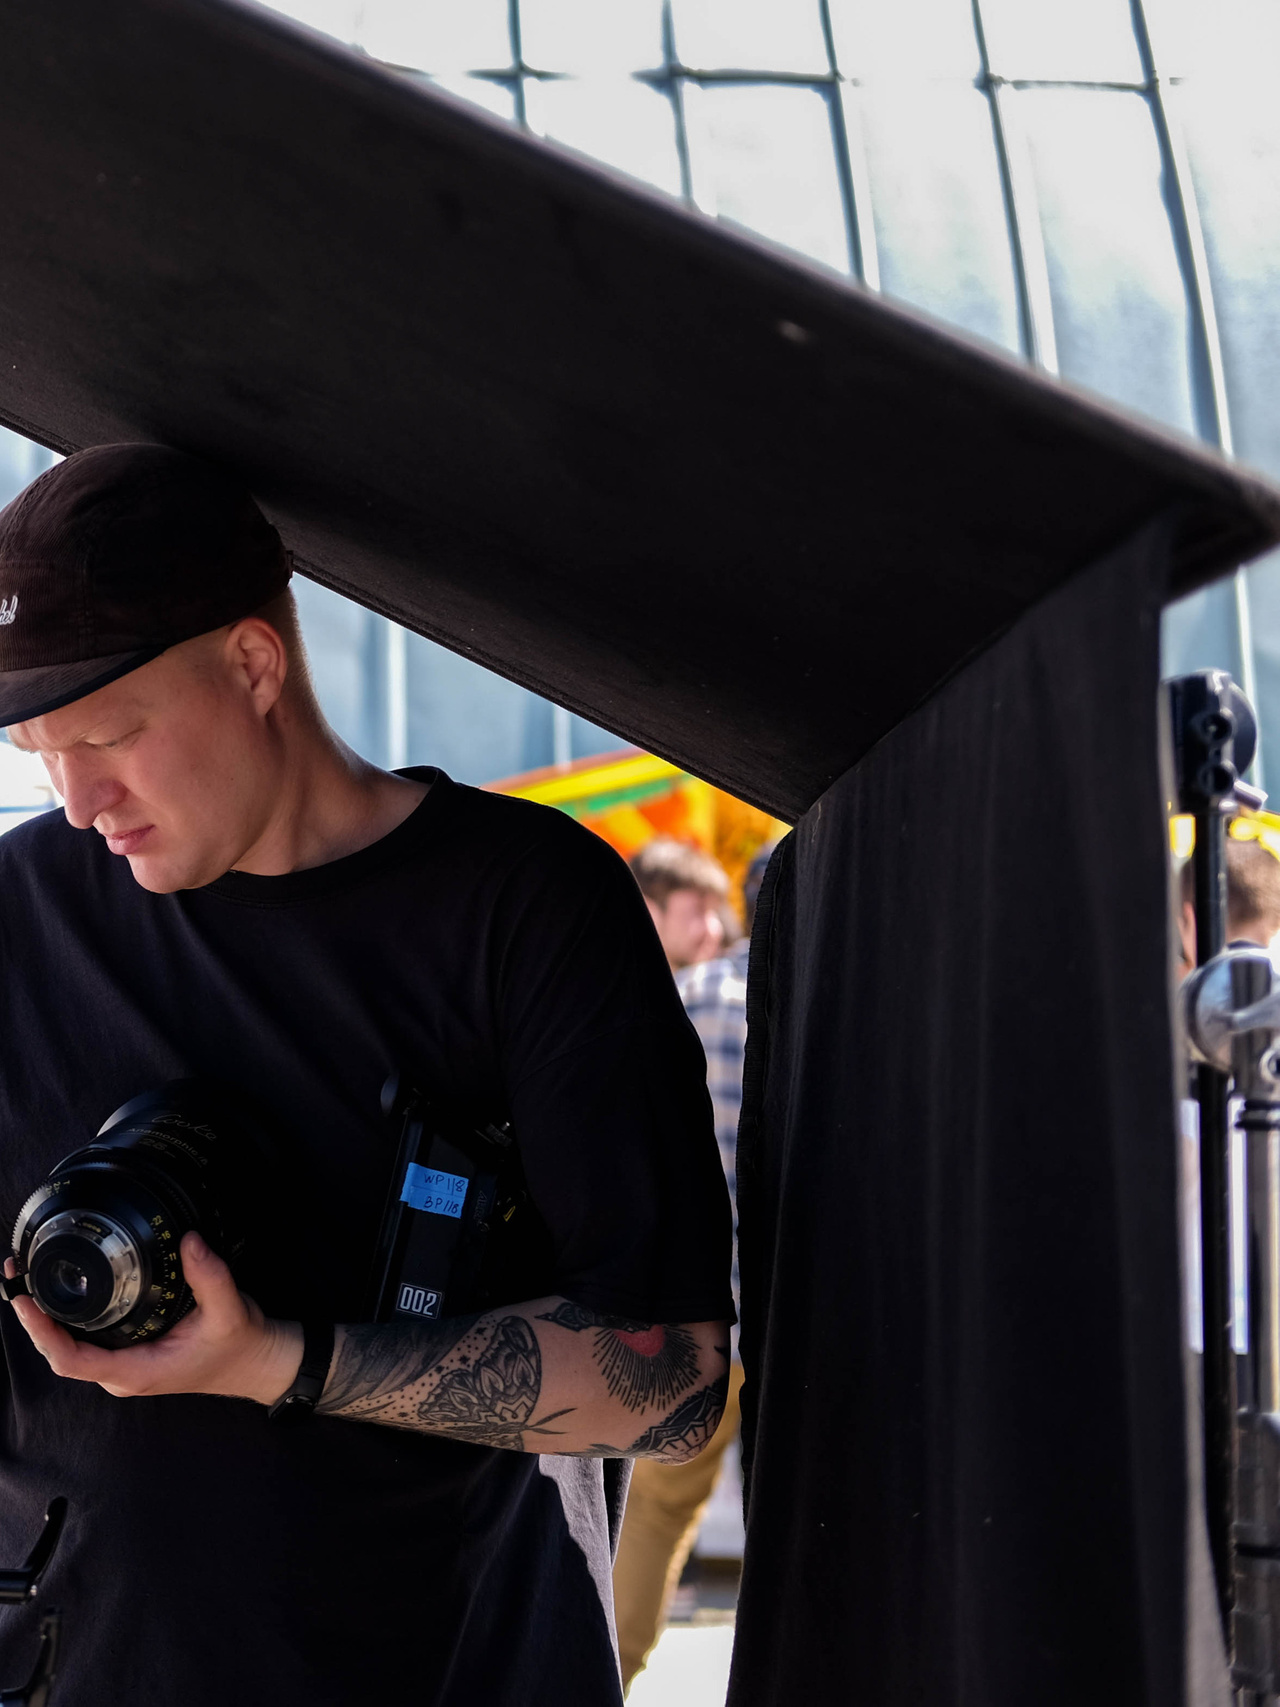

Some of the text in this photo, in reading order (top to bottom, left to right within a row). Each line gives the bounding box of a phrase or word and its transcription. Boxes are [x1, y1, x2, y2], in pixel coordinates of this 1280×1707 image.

[151, 1113, 219, 1142] Cooke
[152, 1215, 164, 1226] 22
[161, 1230, 172, 1240] 16
[169, 1252, 177, 1262] 11
[170, 1271, 177, 1280] 8
[399, 1286, 438, 1316] 002
